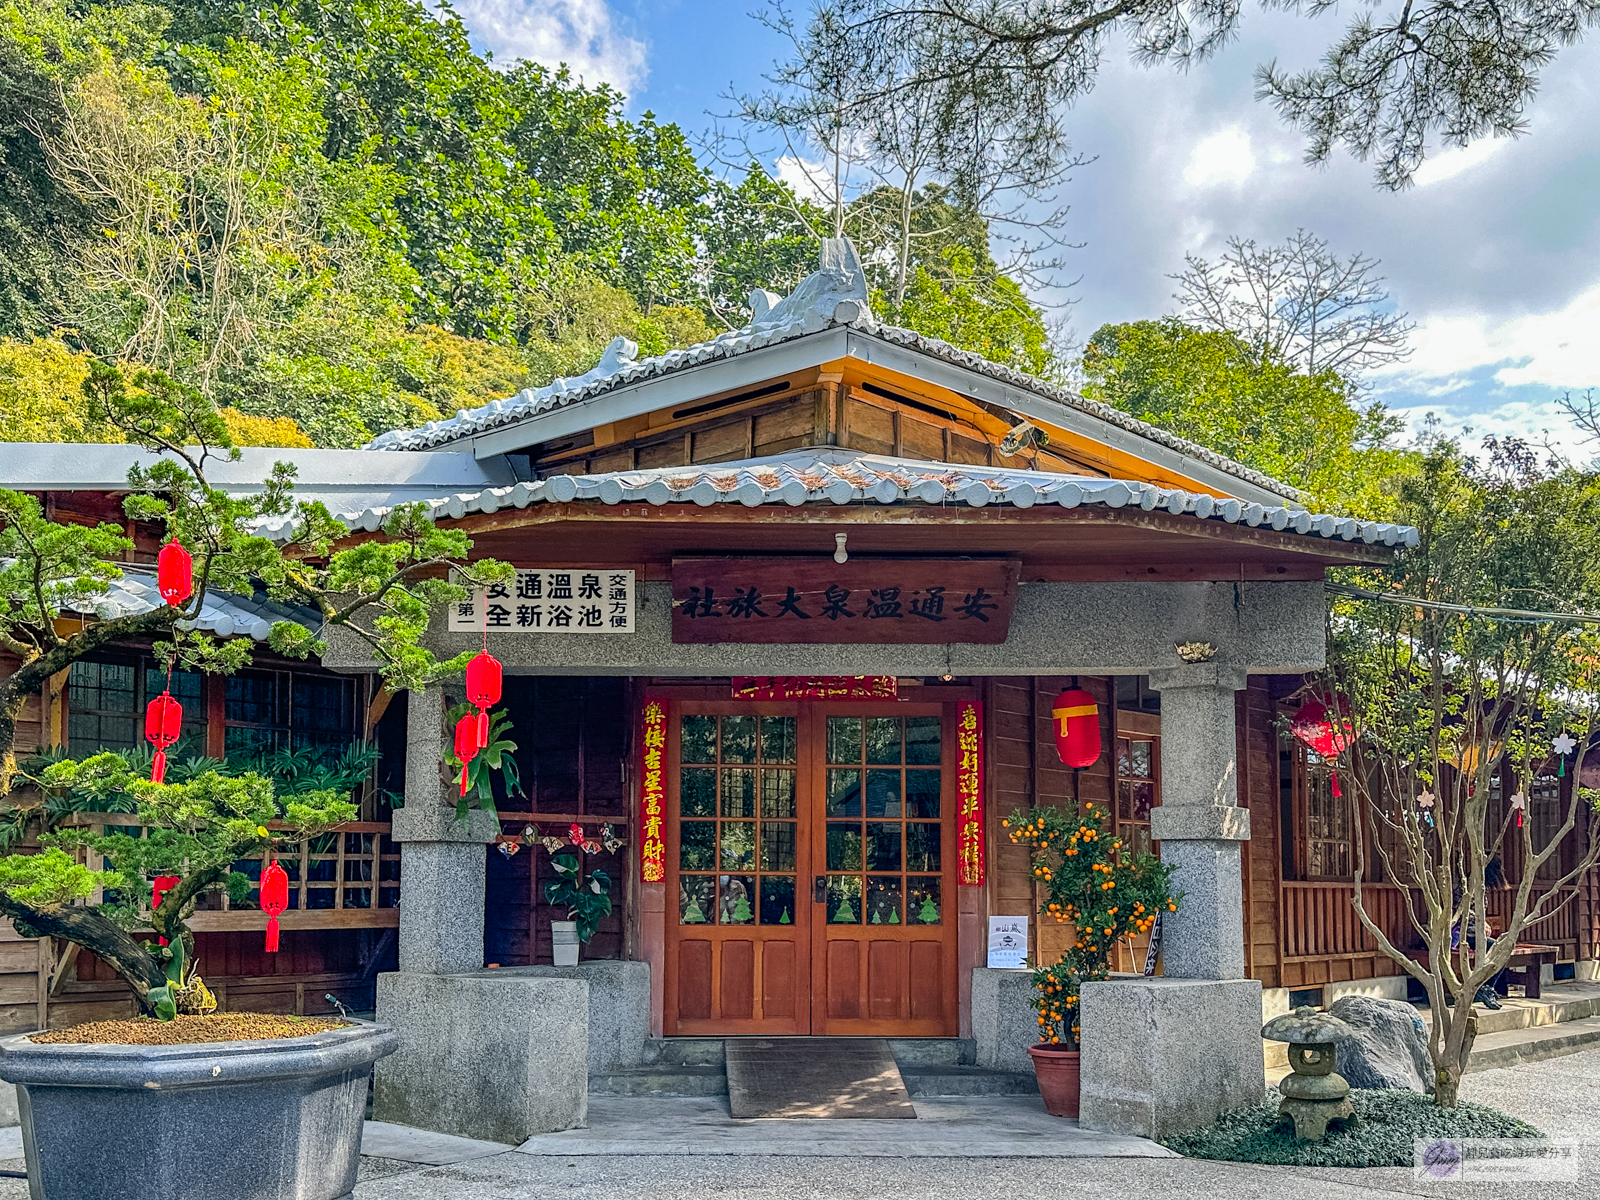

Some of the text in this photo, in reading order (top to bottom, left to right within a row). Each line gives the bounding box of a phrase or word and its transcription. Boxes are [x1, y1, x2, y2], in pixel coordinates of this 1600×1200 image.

[486, 604, 604, 627] 全新浴池
[608, 574, 628, 628] 交通方便
